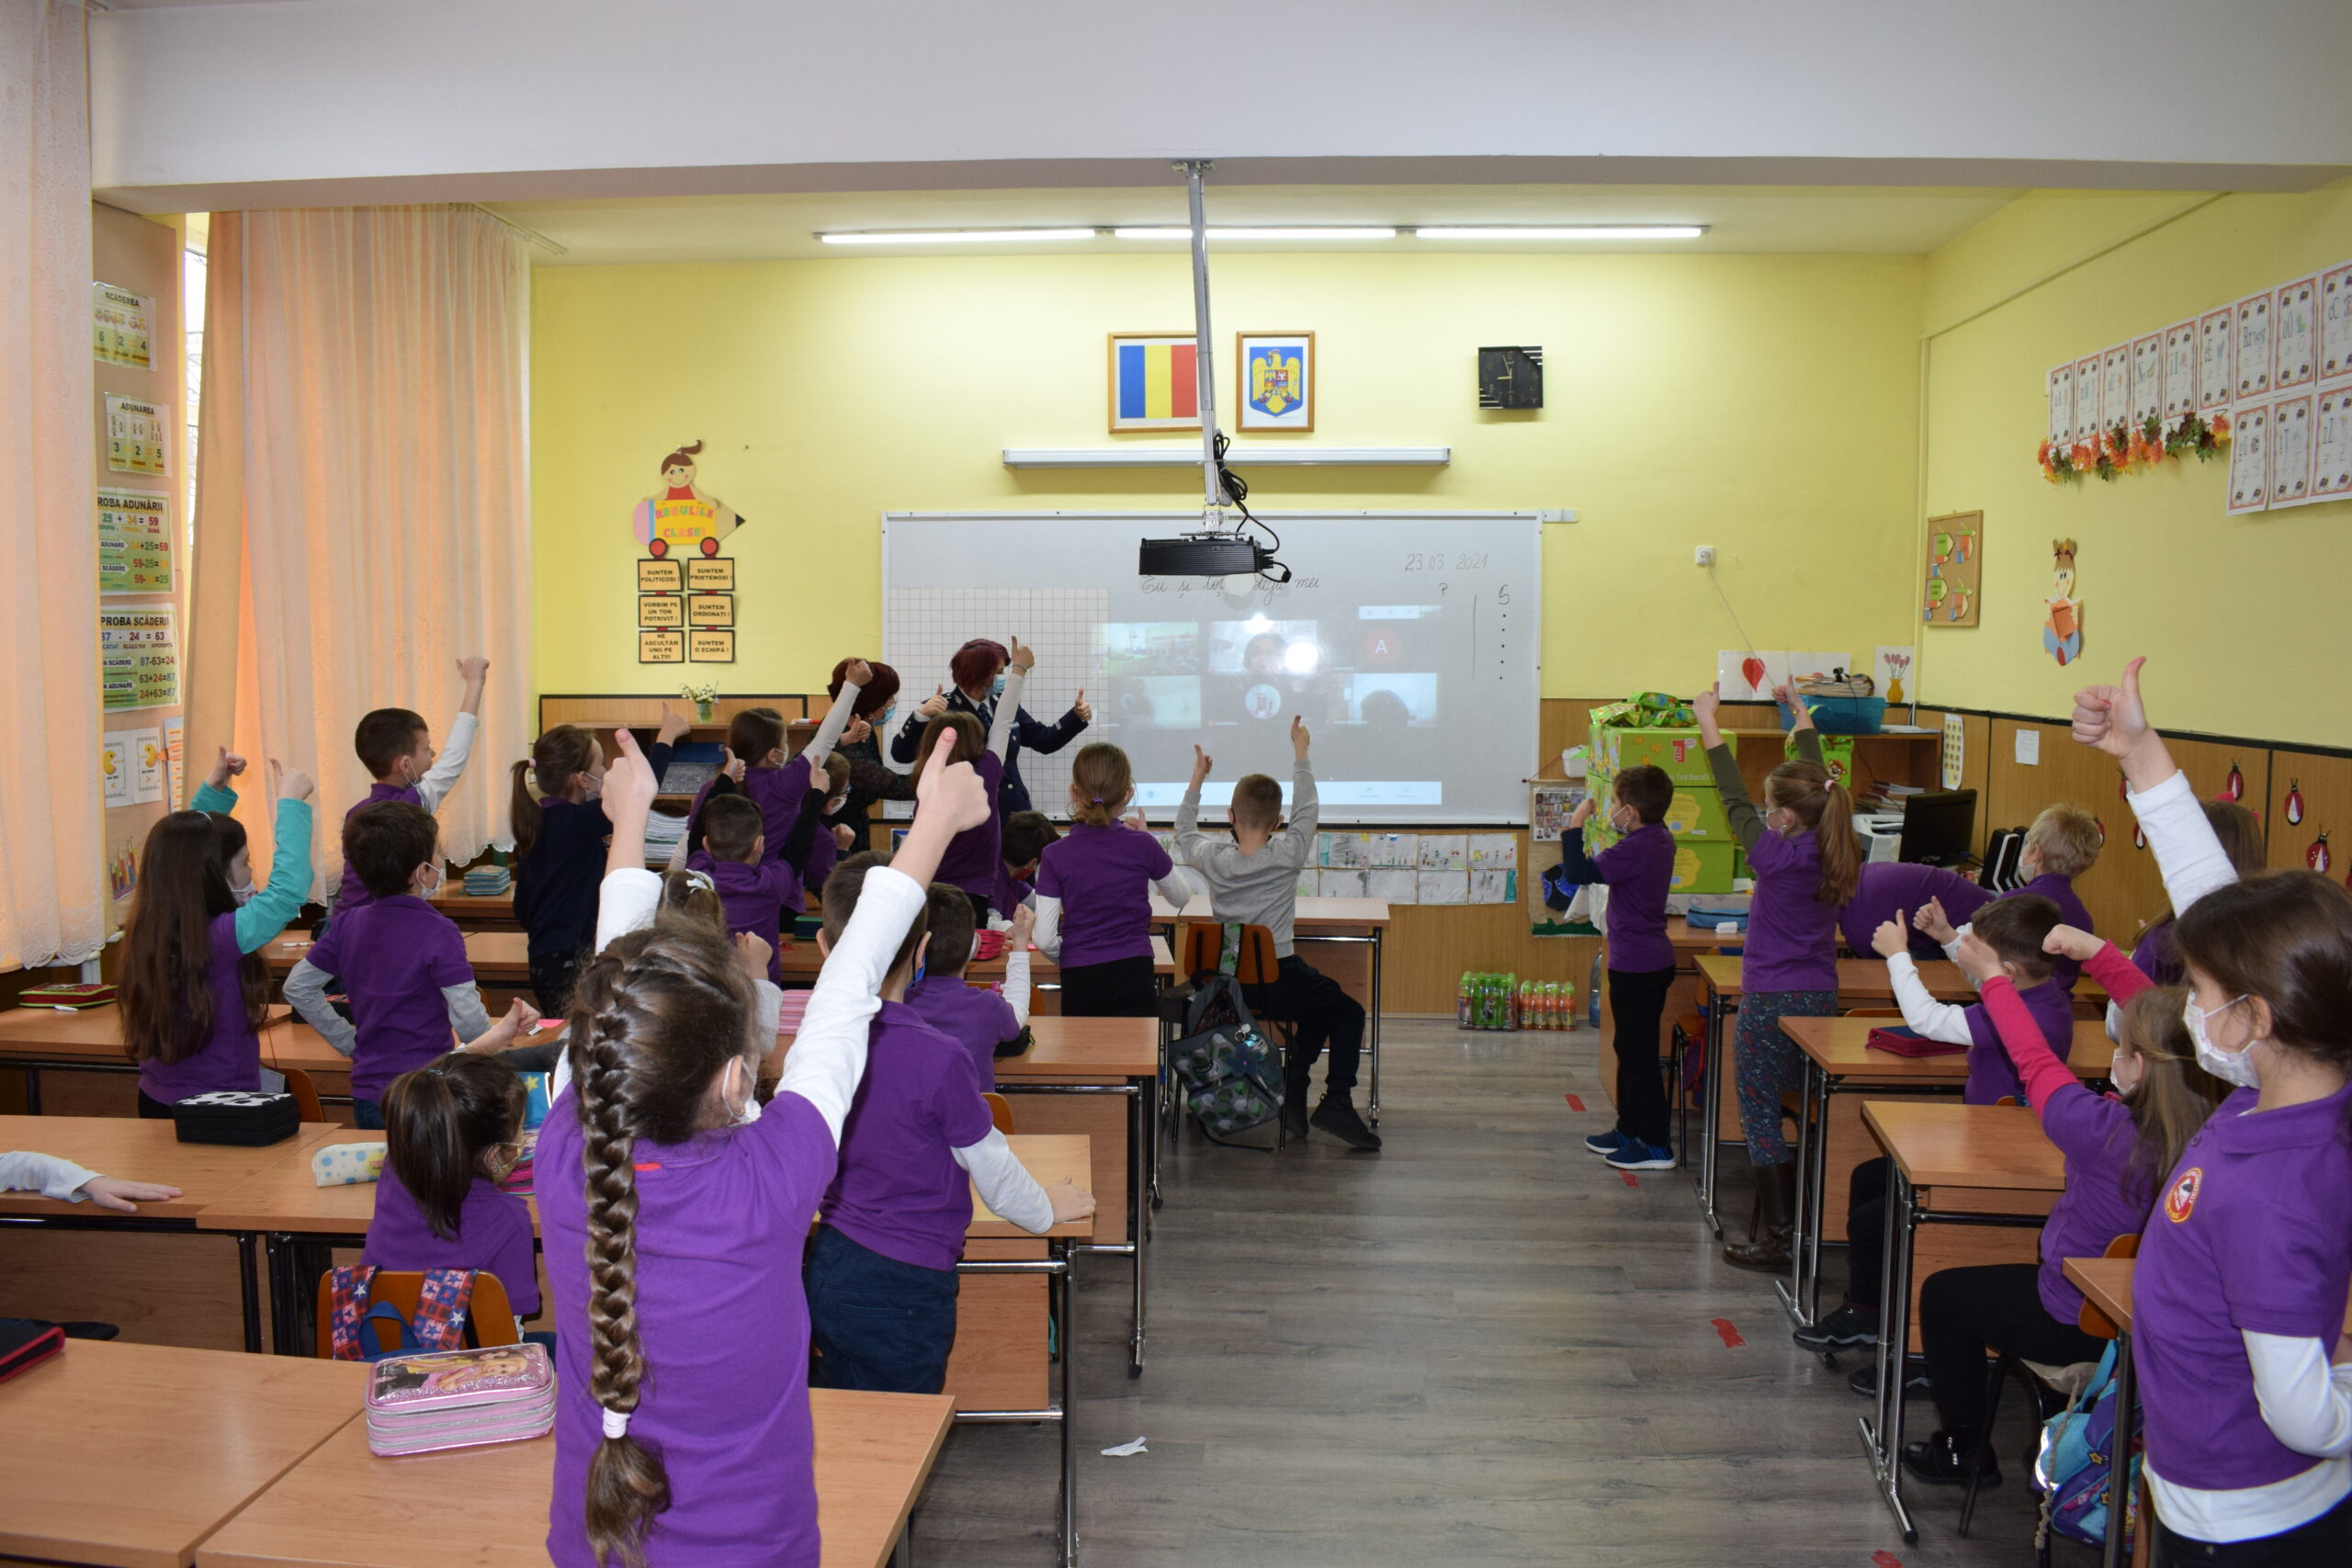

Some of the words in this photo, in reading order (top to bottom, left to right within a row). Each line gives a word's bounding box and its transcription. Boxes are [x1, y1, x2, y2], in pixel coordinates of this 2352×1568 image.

[118, 335, 125, 346] 2
[141, 341, 147, 351] 4
[120, 402, 154, 415] ADUNAREA
[113, 442, 119, 453] 3
[135, 446, 141, 456] 2
[156, 448, 162, 458] 5
[97, 497, 120, 508] ROBA
[123, 500, 163, 512] ADUNĂRII
[102, 513, 113, 524] 25
[149, 516, 159, 526] 59
[100, 616, 131, 626] PROBA
[130, 631, 140, 641] 24
[155, 631, 164, 641] 63
[1374, 638, 1388, 654] A
